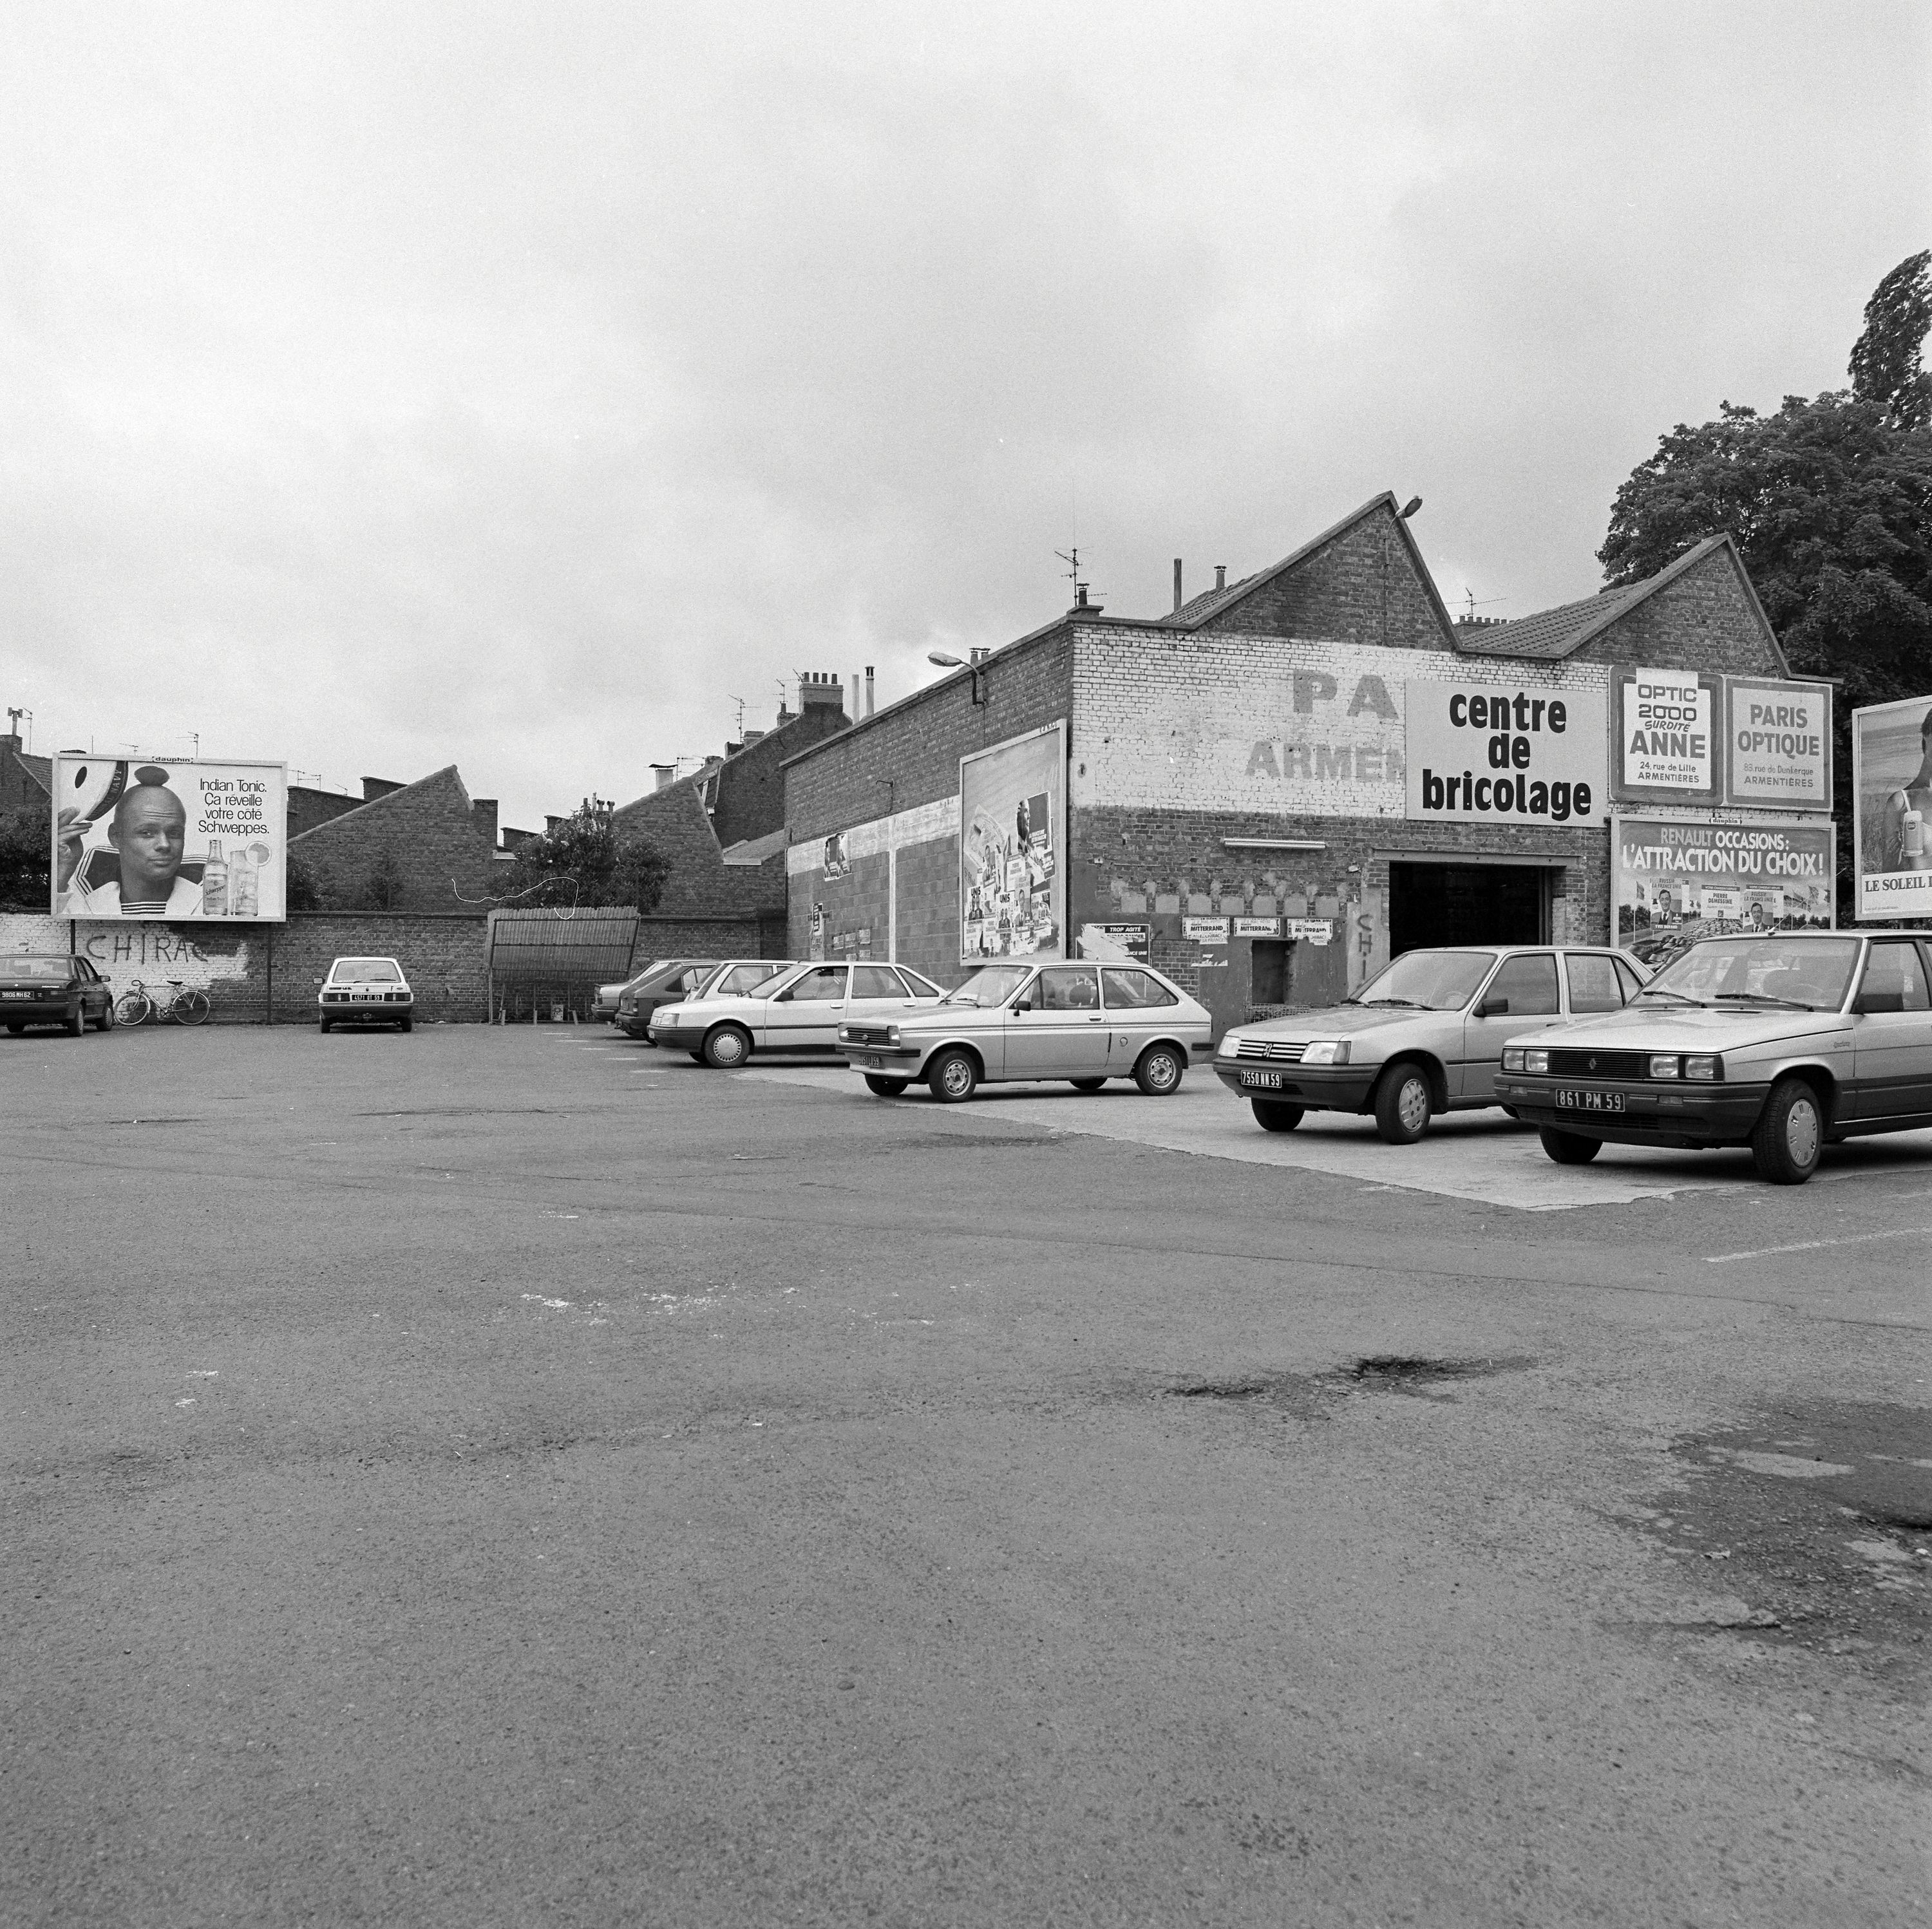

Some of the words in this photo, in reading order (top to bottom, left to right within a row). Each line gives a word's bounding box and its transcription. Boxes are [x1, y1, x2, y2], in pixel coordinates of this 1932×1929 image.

[1638, 684, 1697, 702] OPTIC
[1449, 692, 1567, 733] centre
[1638, 704, 1697, 721] 2000
[1750, 704, 1808, 728] PARIS
[1644, 720, 1691, 732] SURDITÉ
[1488, 733, 1531, 769] de
[1629, 730, 1705, 759] ANNE
[1738, 730, 1820, 760] OPTIQUE
[1678, 764, 1696, 773] Lille
[1777, 765, 1814, 776] Dunkerque
[110, 769, 122, 793] NAVY
[200, 778, 234, 791] Indian
[237, 779, 267, 793] Tonic.
[204, 793, 221, 807] Ça
[225, 794, 262, 806] réveille
[1422, 769, 1591, 822] bricolage
[205, 807, 234, 819] votre
[237, 808, 262, 820] côté
[198, 820, 269, 836] Schweppes.
[1660, 827, 1713, 847] RENAULT
[1715, 831, 1789, 851] OCCASIONS:
[1623, 843, 1734, 872] L'ATTRACTION
[1738, 851, 1762, 874] DU
[1865, 880, 1880, 892] LE
[1882, 876, 1926, 891] SOLEIL
[999, 893, 1010, 903] UNIS
[1243, 1071, 1259, 1084] 7550
[1271, 1074, 1280, 1087] 59
[1560, 1091, 1579, 1107] 861
[1586, 1093, 1601, 1109] PM
[1606, 1094, 1621, 1110] 59
